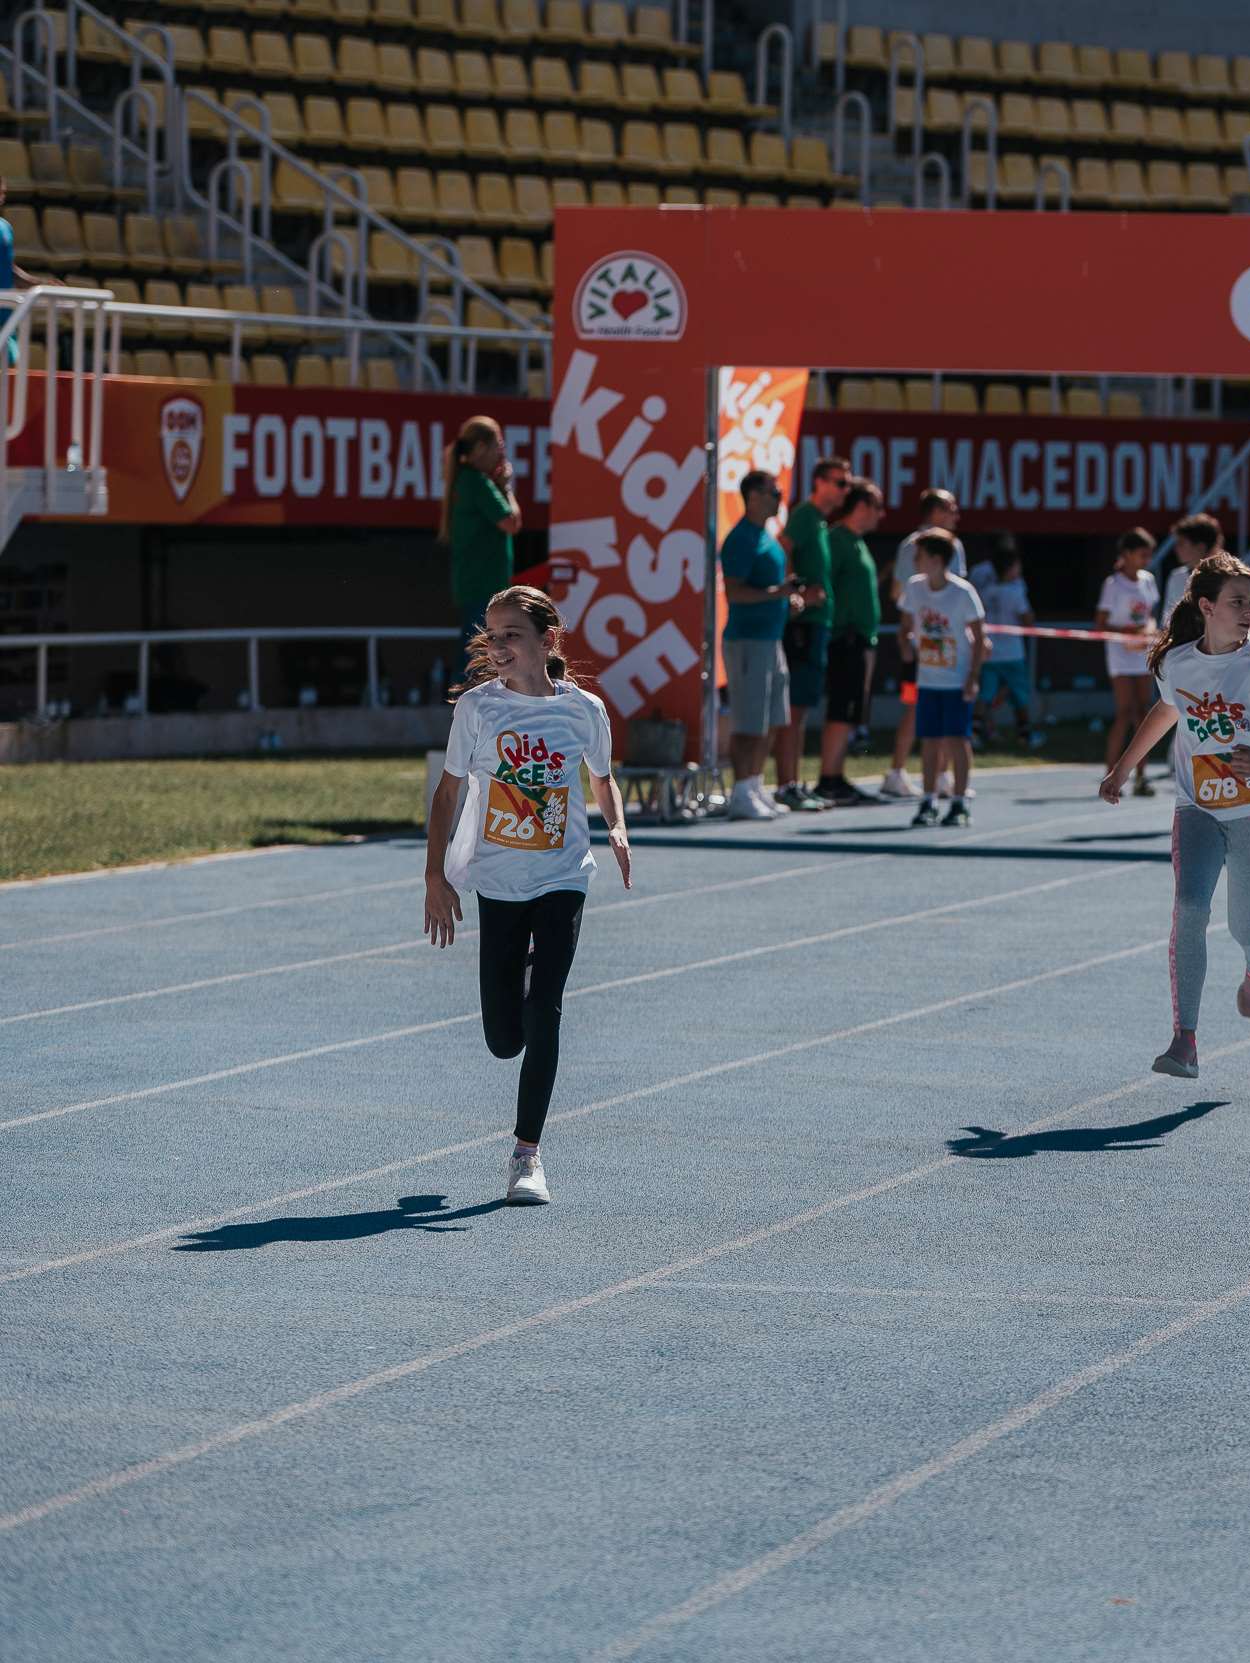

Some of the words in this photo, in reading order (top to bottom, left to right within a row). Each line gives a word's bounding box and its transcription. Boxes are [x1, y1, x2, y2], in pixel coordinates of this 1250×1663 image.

[587, 262, 673, 322] VITALIA
[221, 414, 446, 500] FOOTBAL
[850, 435, 918, 508] OF
[929, 438, 1243, 511] MACEDONIA
[550, 350, 707, 532] kids
[503, 734, 566, 771] kids
[1199, 777, 1239, 801] 678
[489, 807, 535, 840] 726
